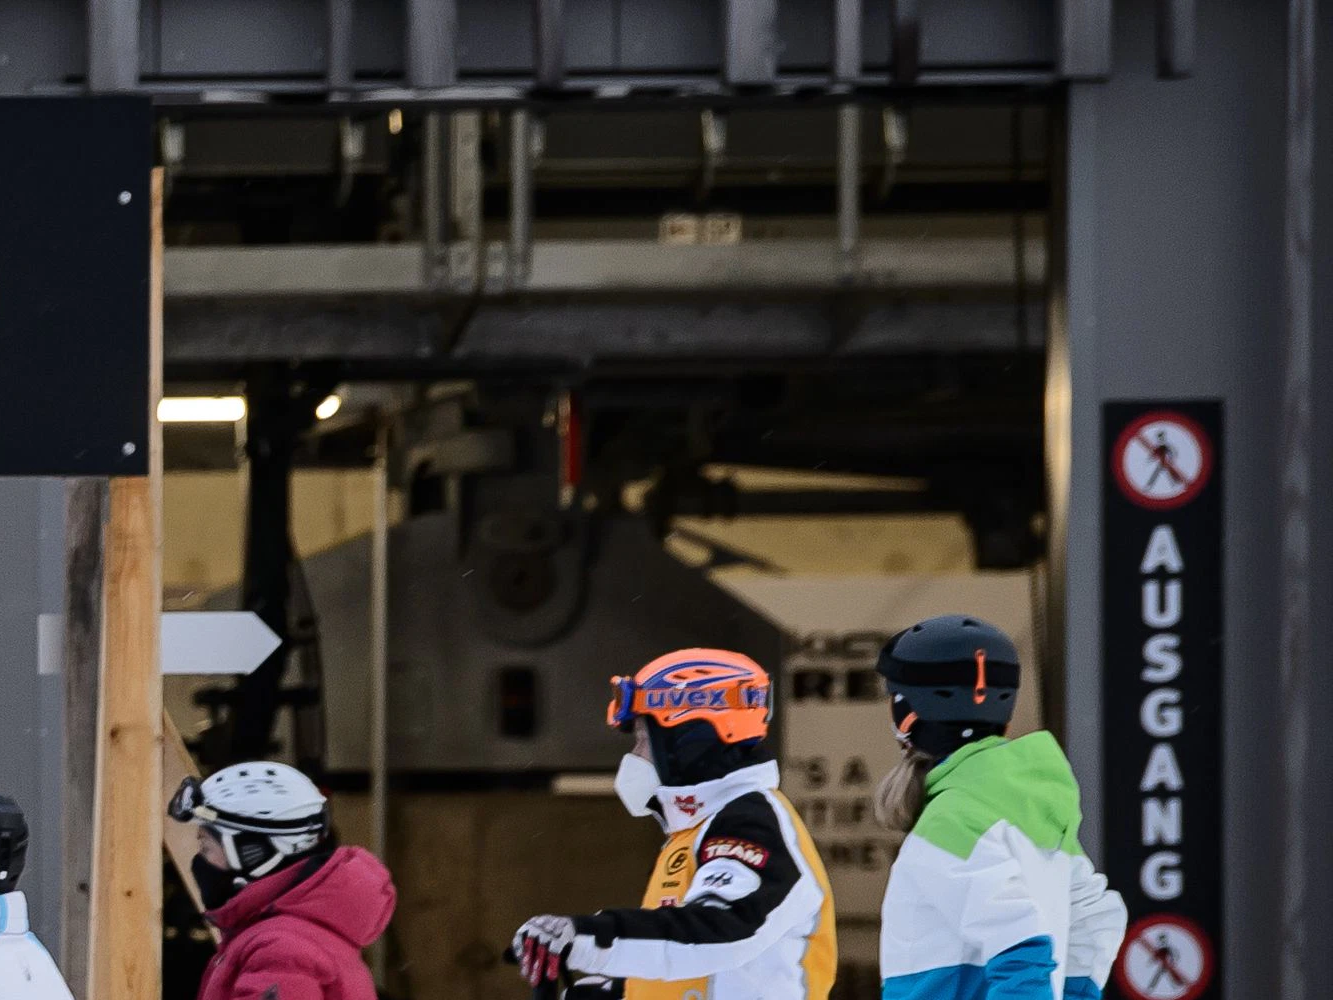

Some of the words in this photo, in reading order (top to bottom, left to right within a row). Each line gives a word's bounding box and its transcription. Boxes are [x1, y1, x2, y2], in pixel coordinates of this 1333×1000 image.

[646, 687, 728, 708] uvex
[1139, 524, 1184, 901] AUSGANG
[704, 843, 764, 866] TEAM
